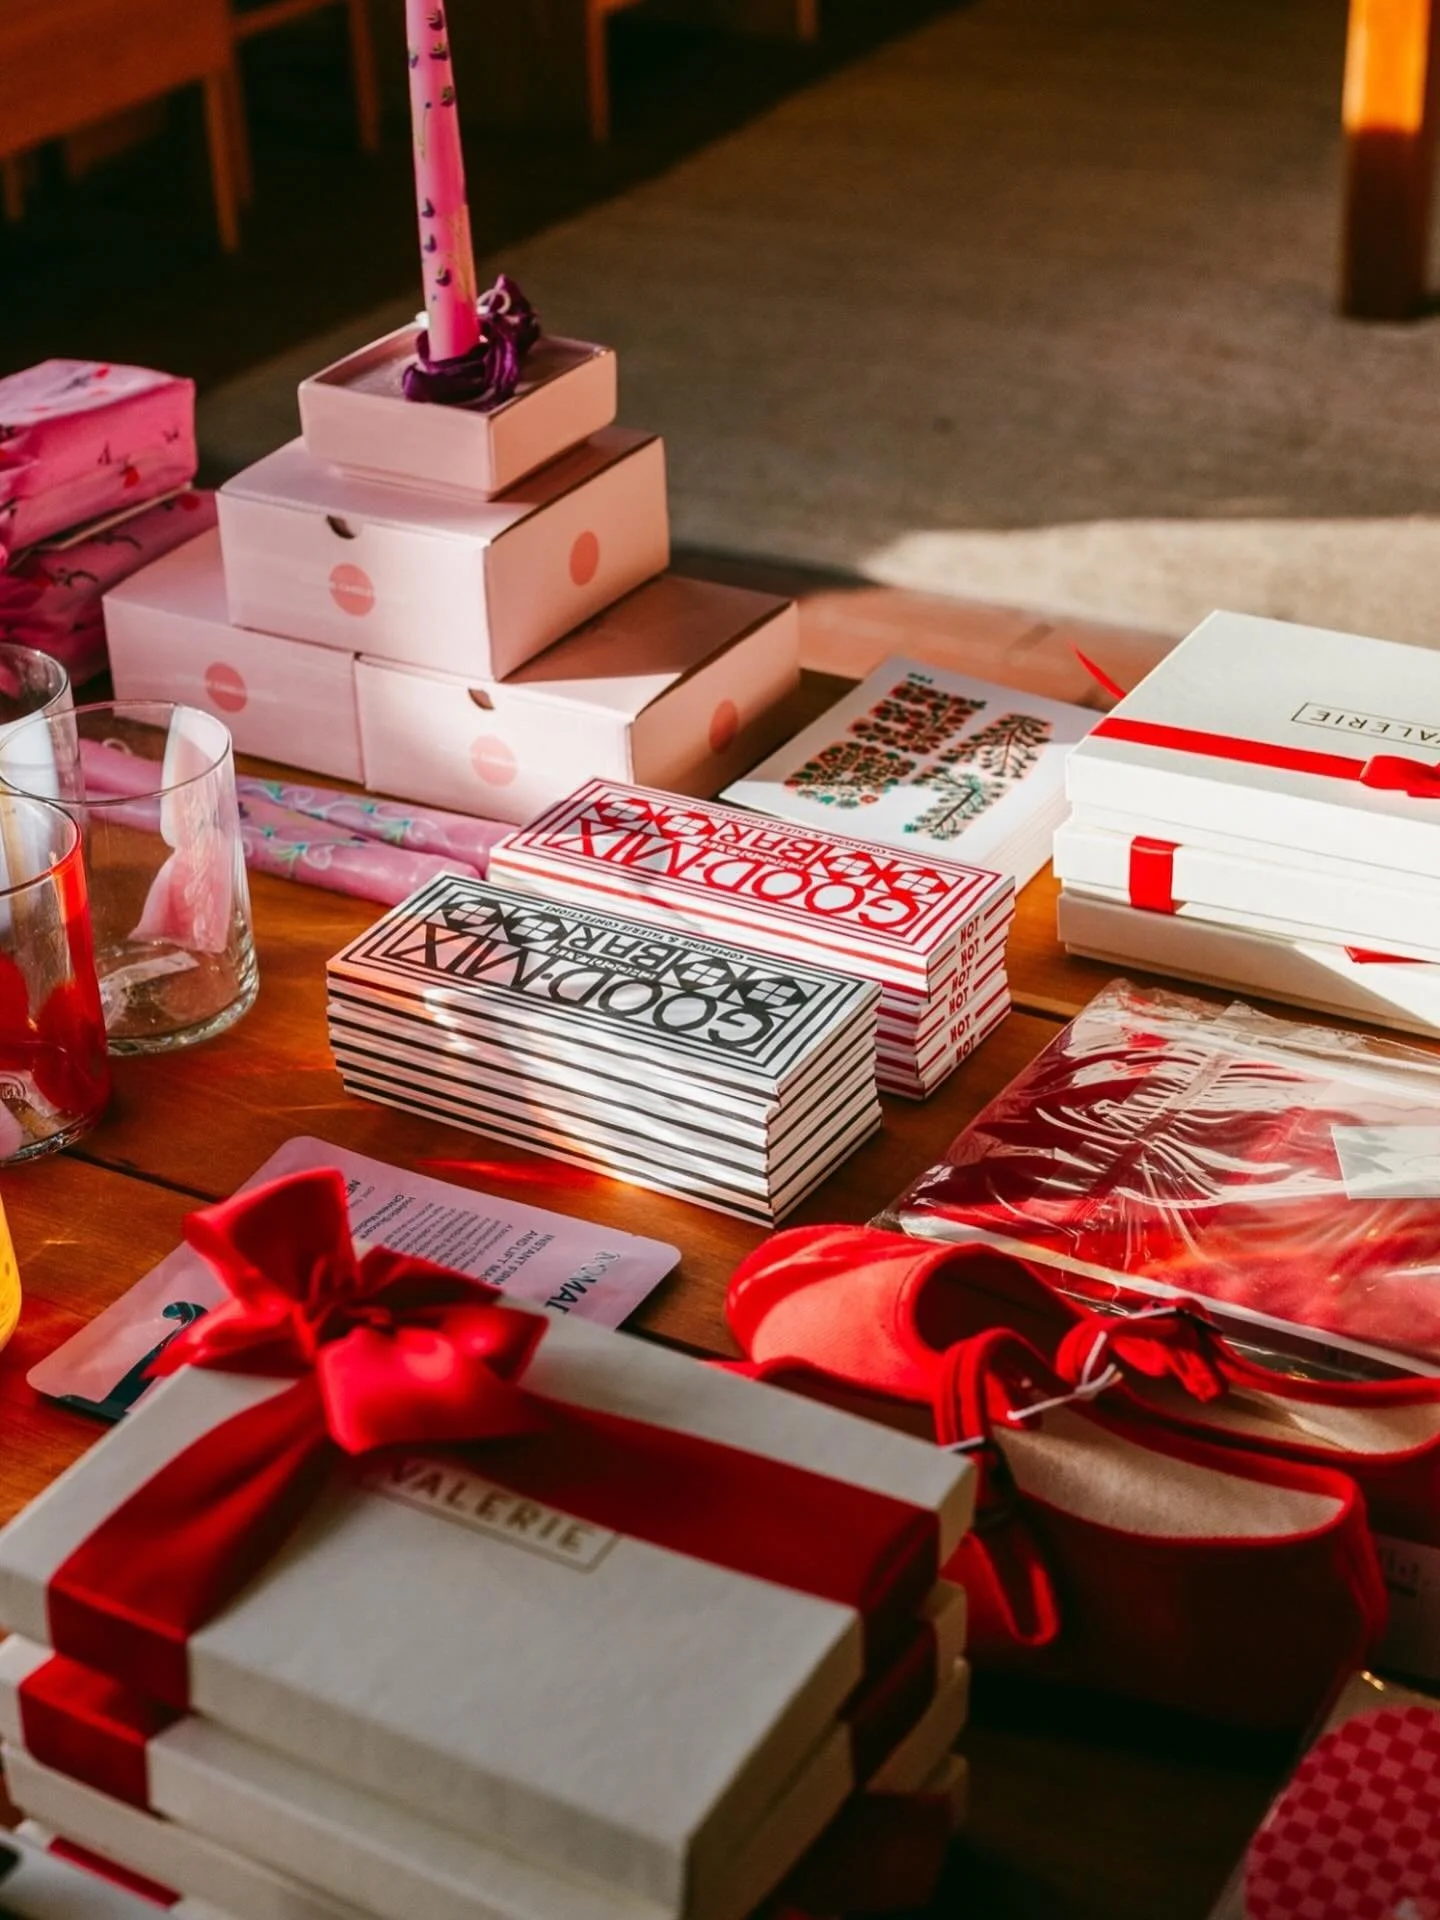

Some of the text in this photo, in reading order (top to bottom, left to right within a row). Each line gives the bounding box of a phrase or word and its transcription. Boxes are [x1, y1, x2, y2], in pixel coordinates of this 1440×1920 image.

[1310, 709, 1440, 744] ALERIE
[712, 823, 823, 861] BAR
[542, 904, 620, 927] CONFECTIONS
[619, 924, 666, 939] VALERIE
[561, 925, 678, 970] BAR
[679, 939, 746, 959] COMMUNE
[391, 1461, 596, 1553] VALERIE
